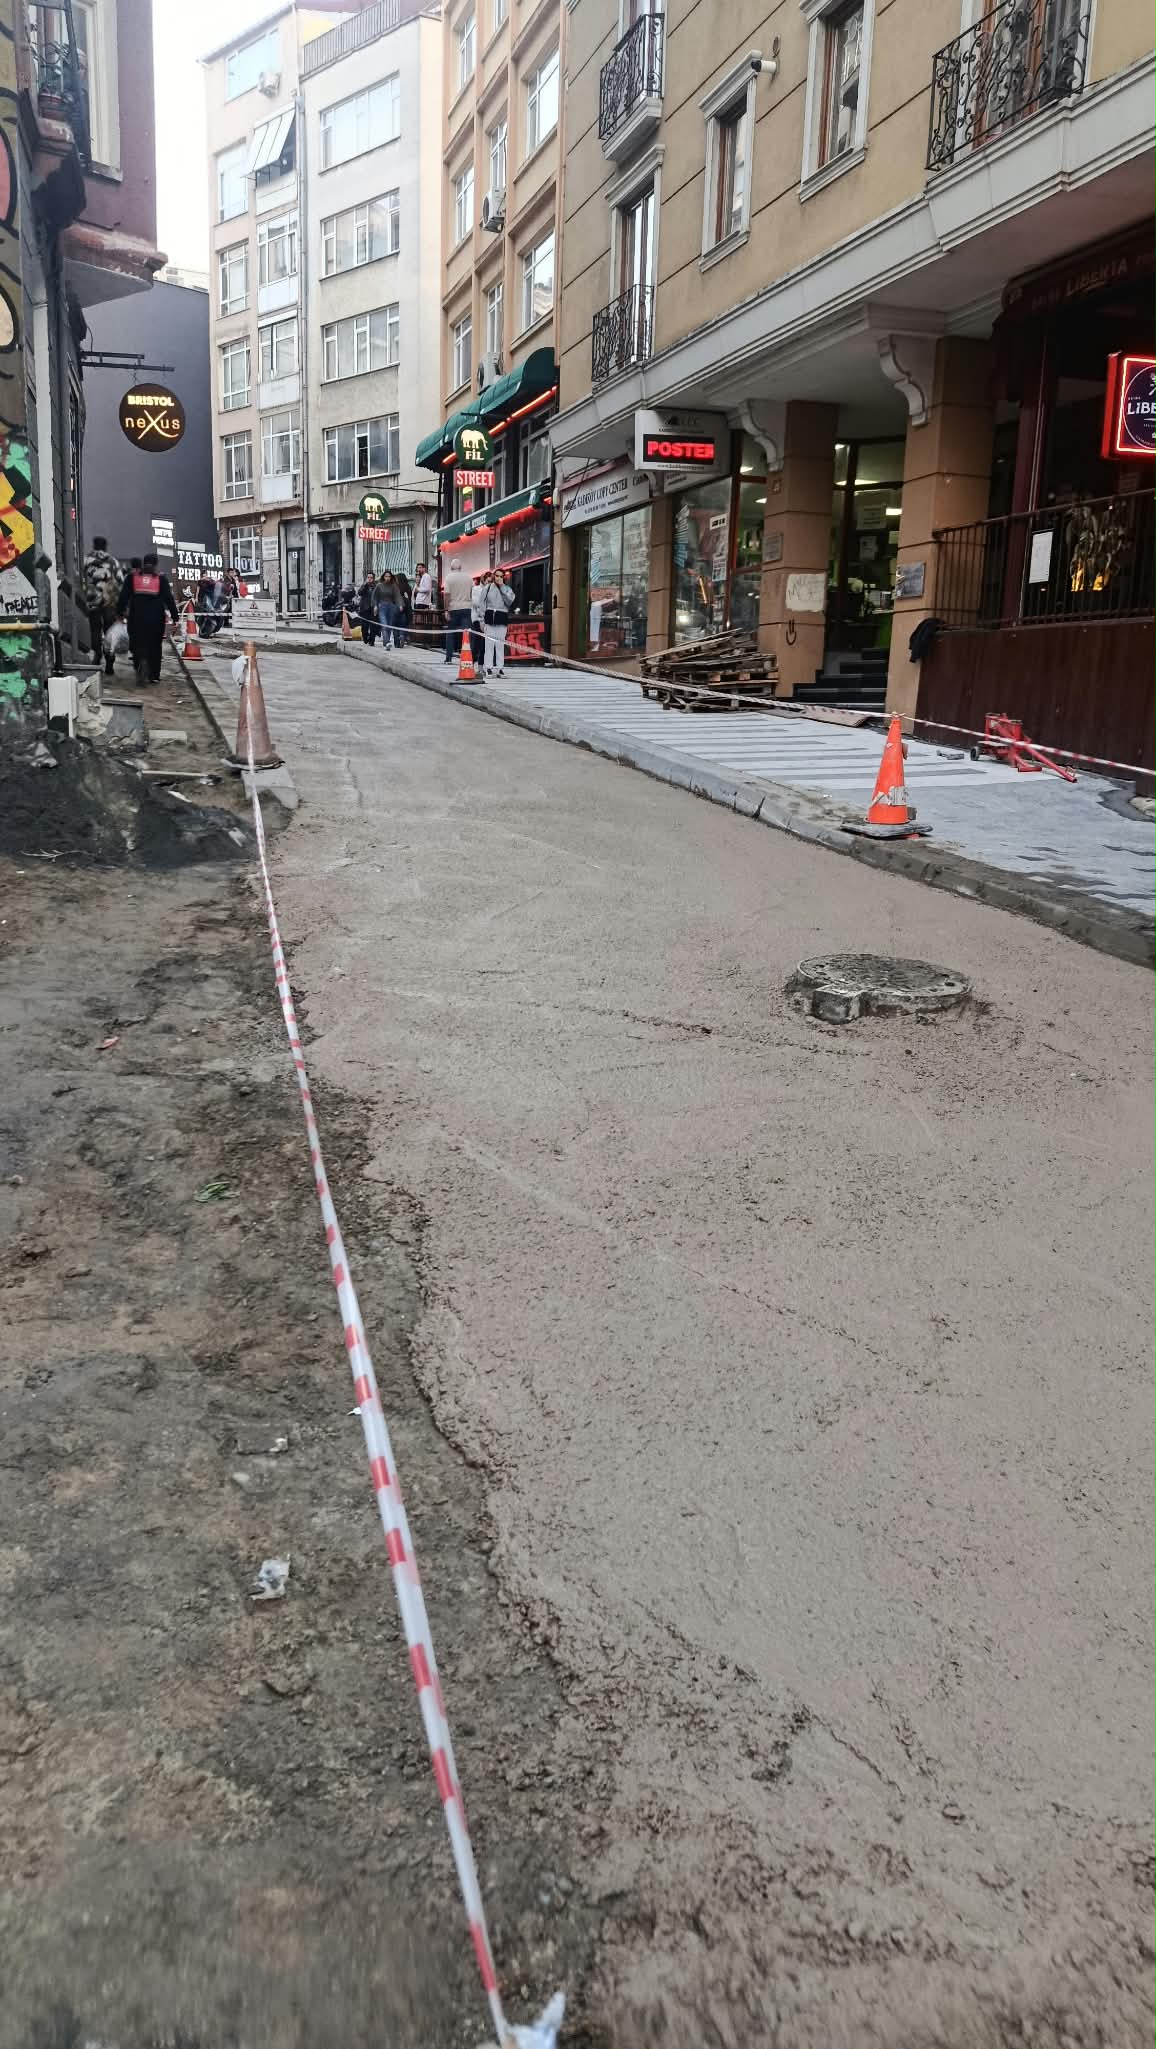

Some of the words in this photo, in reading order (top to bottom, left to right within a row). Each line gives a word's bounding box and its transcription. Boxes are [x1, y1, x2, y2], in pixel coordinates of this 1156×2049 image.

[127, 395, 175, 407] BRISTOL
[465, 449, 485, 461] FİL
[647, 440, 714, 459] POSTER
[456, 470, 493, 486] STREET
[360, 527, 389, 540] STREET
[177, 550, 223, 568] TATTOO
[177, 566, 224, 581] PIERING
